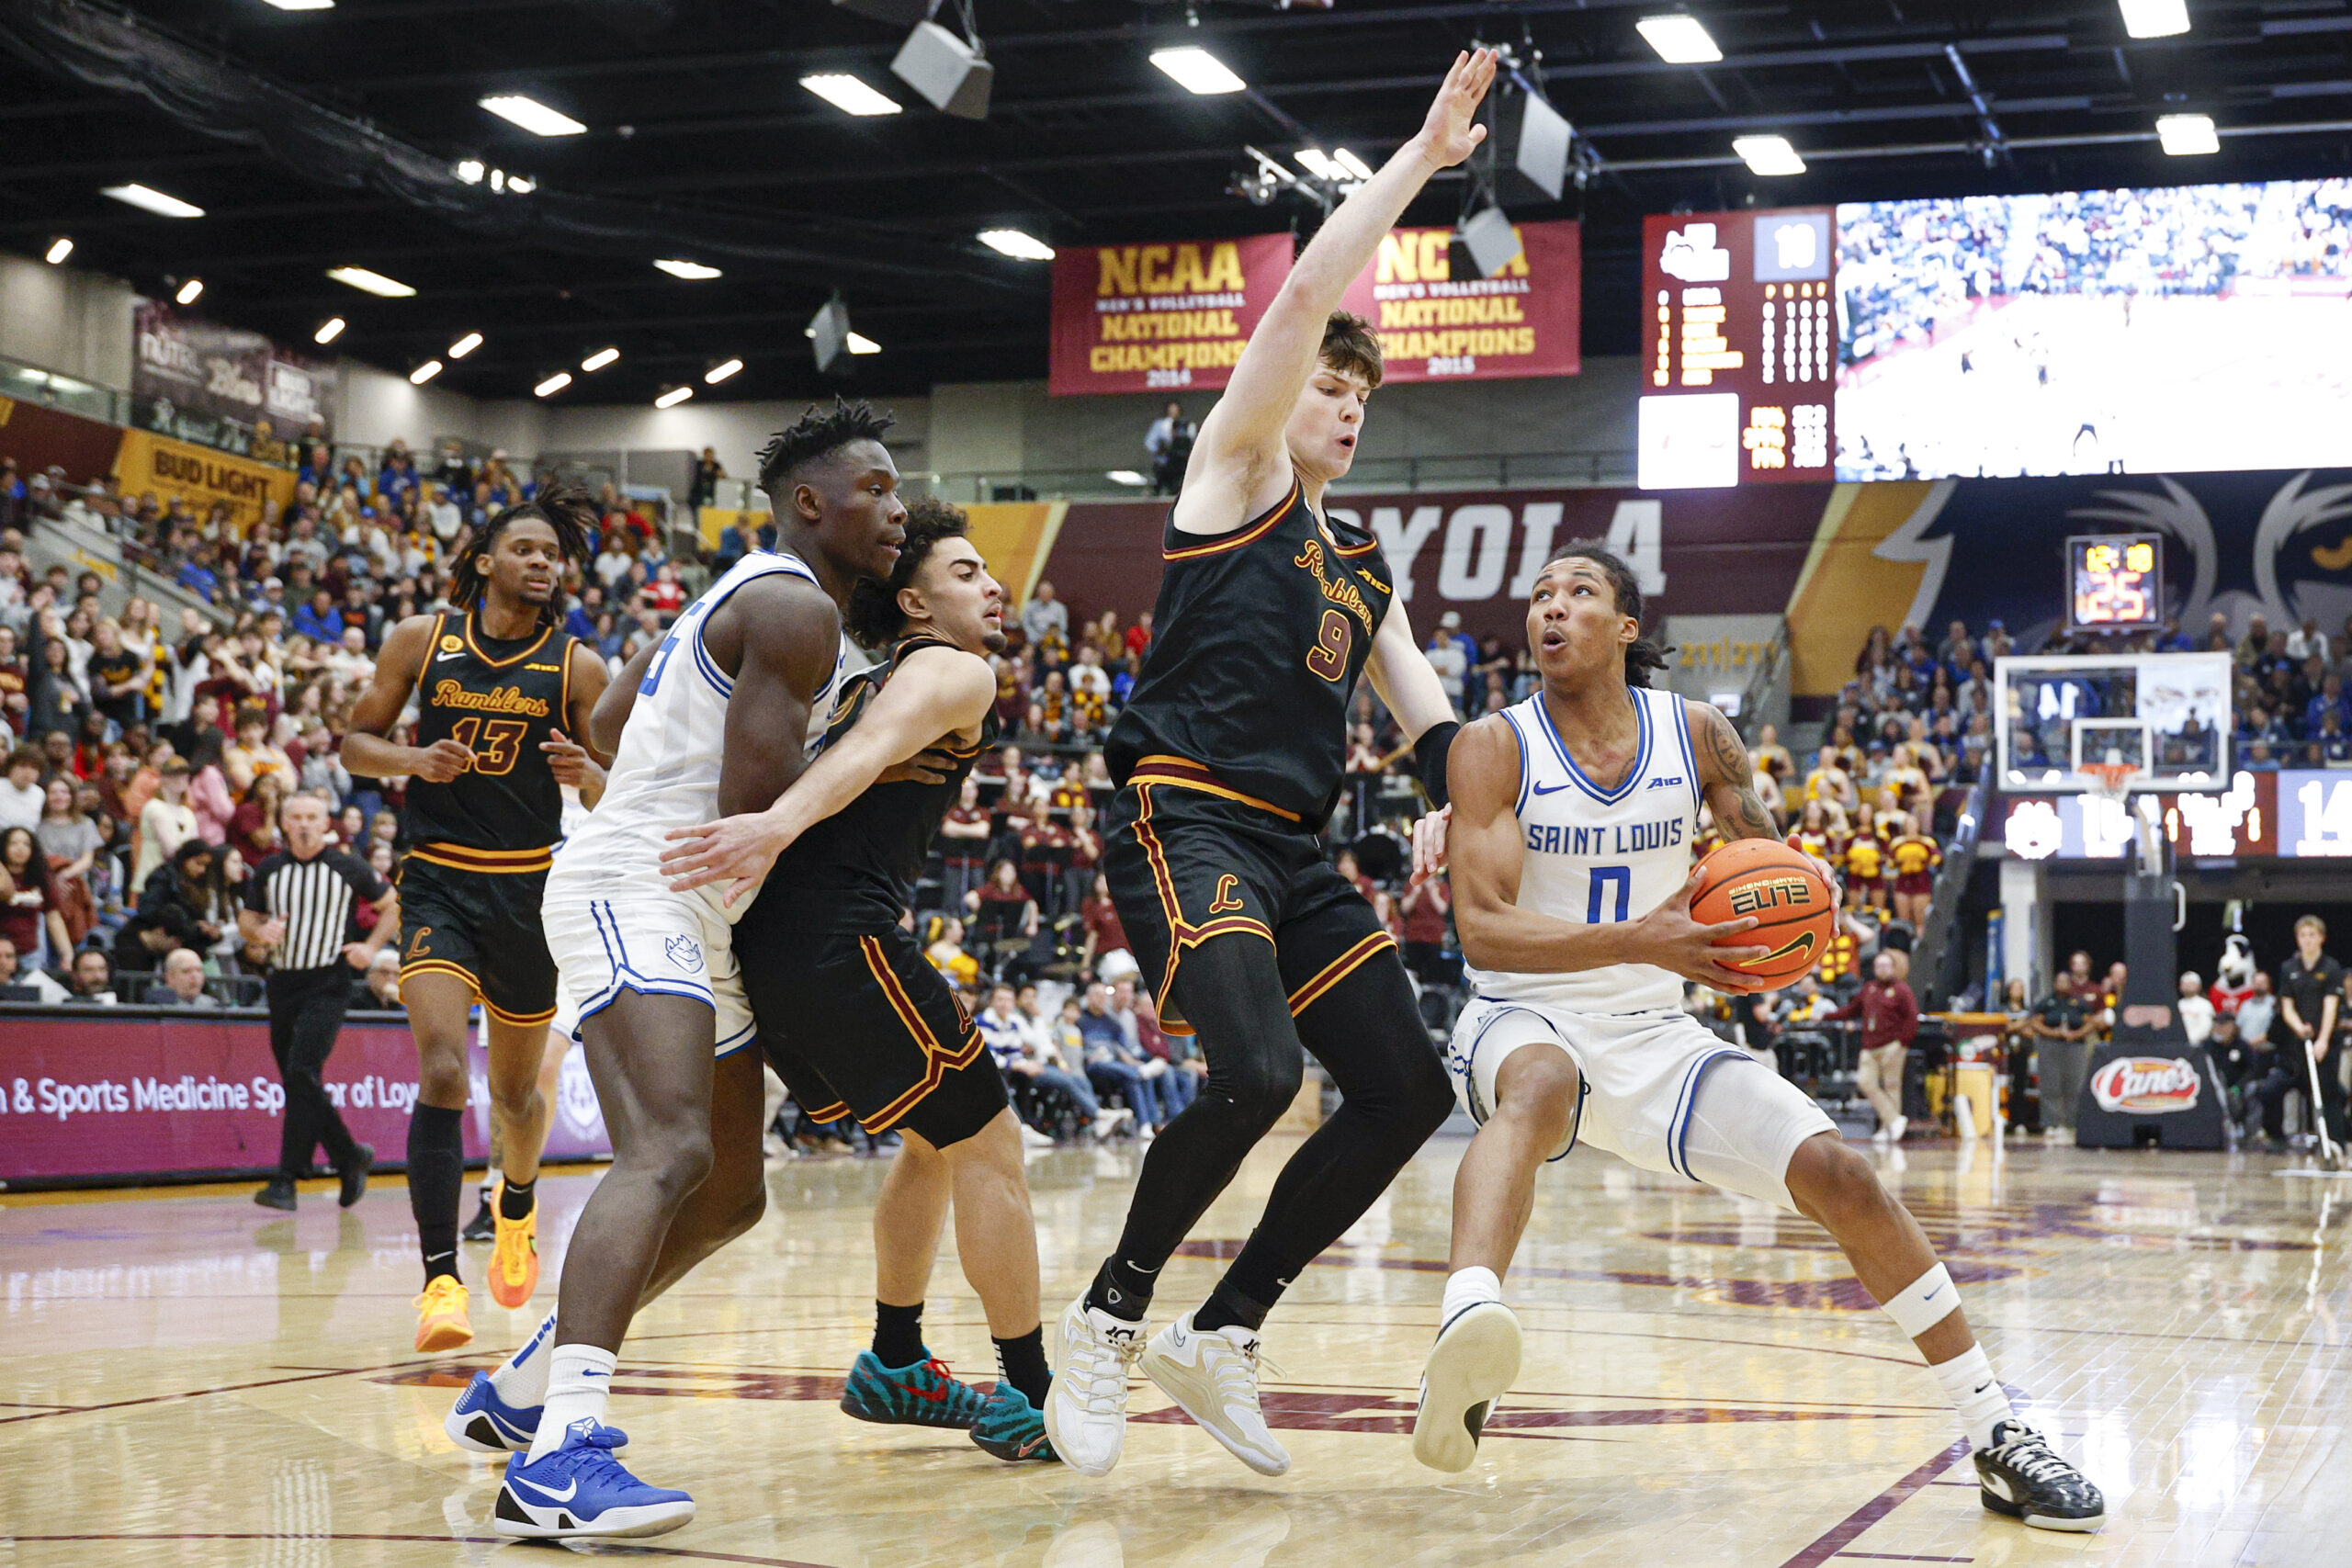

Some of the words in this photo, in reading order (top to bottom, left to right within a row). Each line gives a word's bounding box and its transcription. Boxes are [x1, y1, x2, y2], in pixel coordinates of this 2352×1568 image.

[1097, 242, 1246, 296] NCAA
[1102, 309, 1239, 341] NATIONAL
[1380, 296, 1524, 329] NATIONAL
[154, 448, 202, 485] BUD
[207, 462, 271, 503] LIGHT
[1306, 608, 1352, 682] 9
[431, 679, 549, 717] Ramblers
[451, 716, 528, 775] 13
[1527, 823, 1602, 855] SAINT
[1615, 816, 1683, 854] LOUIS
[1209, 874, 1244, 915] L
[1729, 882, 1812, 917] ELITE
[405, 926, 433, 961] L
[12, 1077, 36, 1114] &
[37, 1076, 130, 1122] Sports
[131, 1074, 250, 1112] Medicine
[349, 1074, 374, 1109] of
